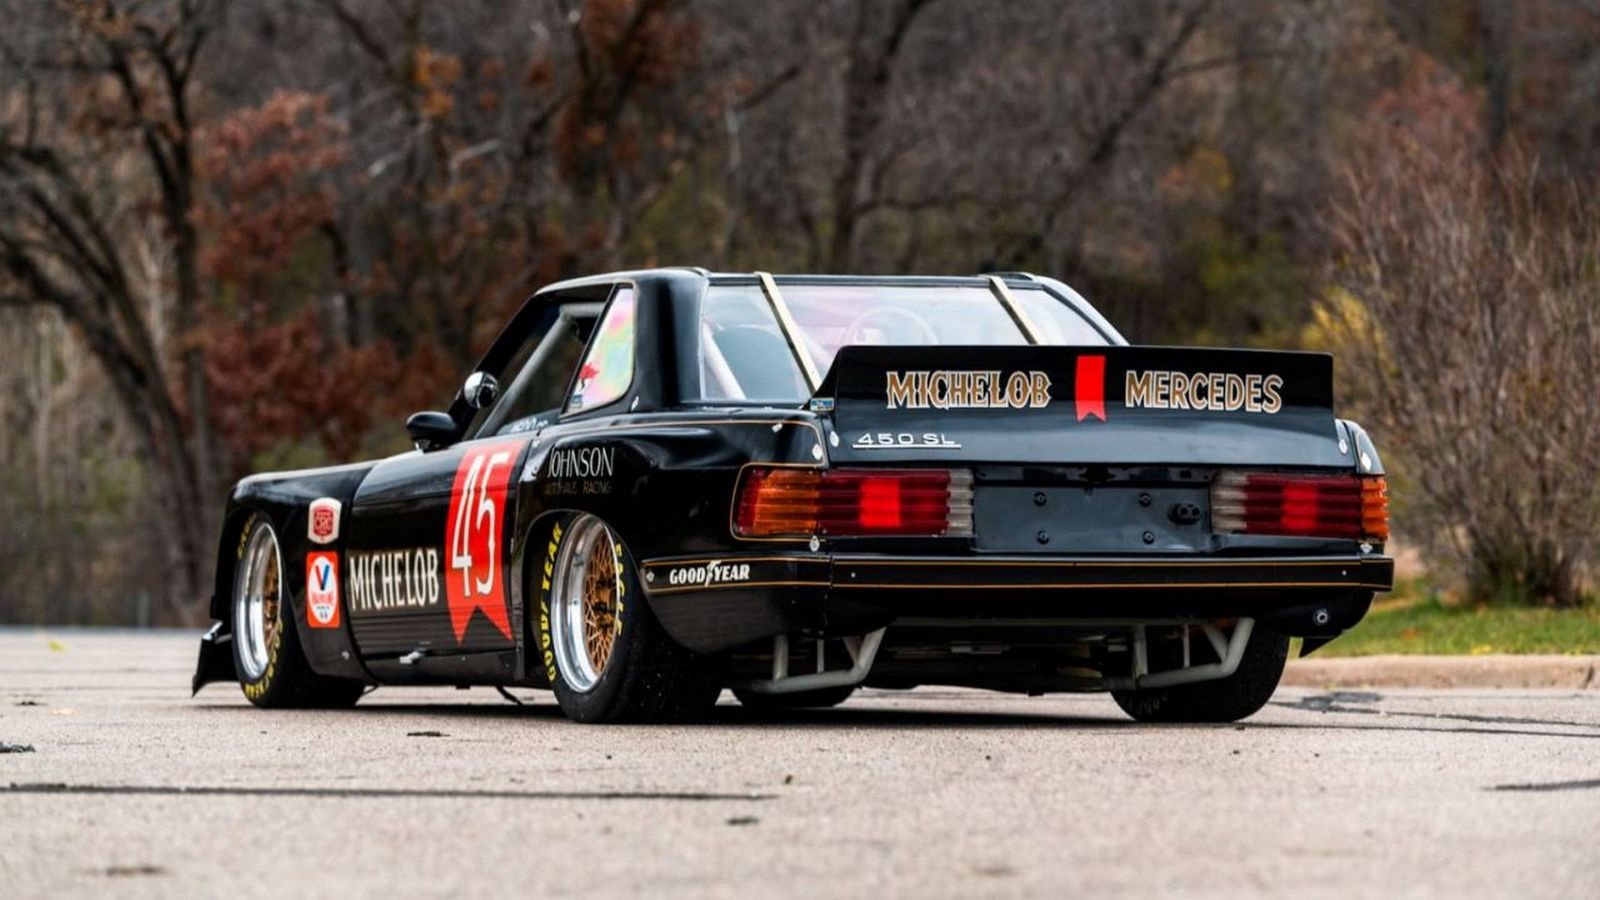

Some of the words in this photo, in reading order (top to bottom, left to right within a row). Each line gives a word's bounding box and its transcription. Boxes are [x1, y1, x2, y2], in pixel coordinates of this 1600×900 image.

[886, 370, 1051, 409] MICHELOB
[1124, 370, 1283, 413] MERCEDES
[857, 433, 914, 446] 450
[922, 434, 956, 446] SL
[547, 447, 615, 478] JOHNSON
[451, 451, 510, 597] 45
[349, 548, 440, 610] MICHELOB
